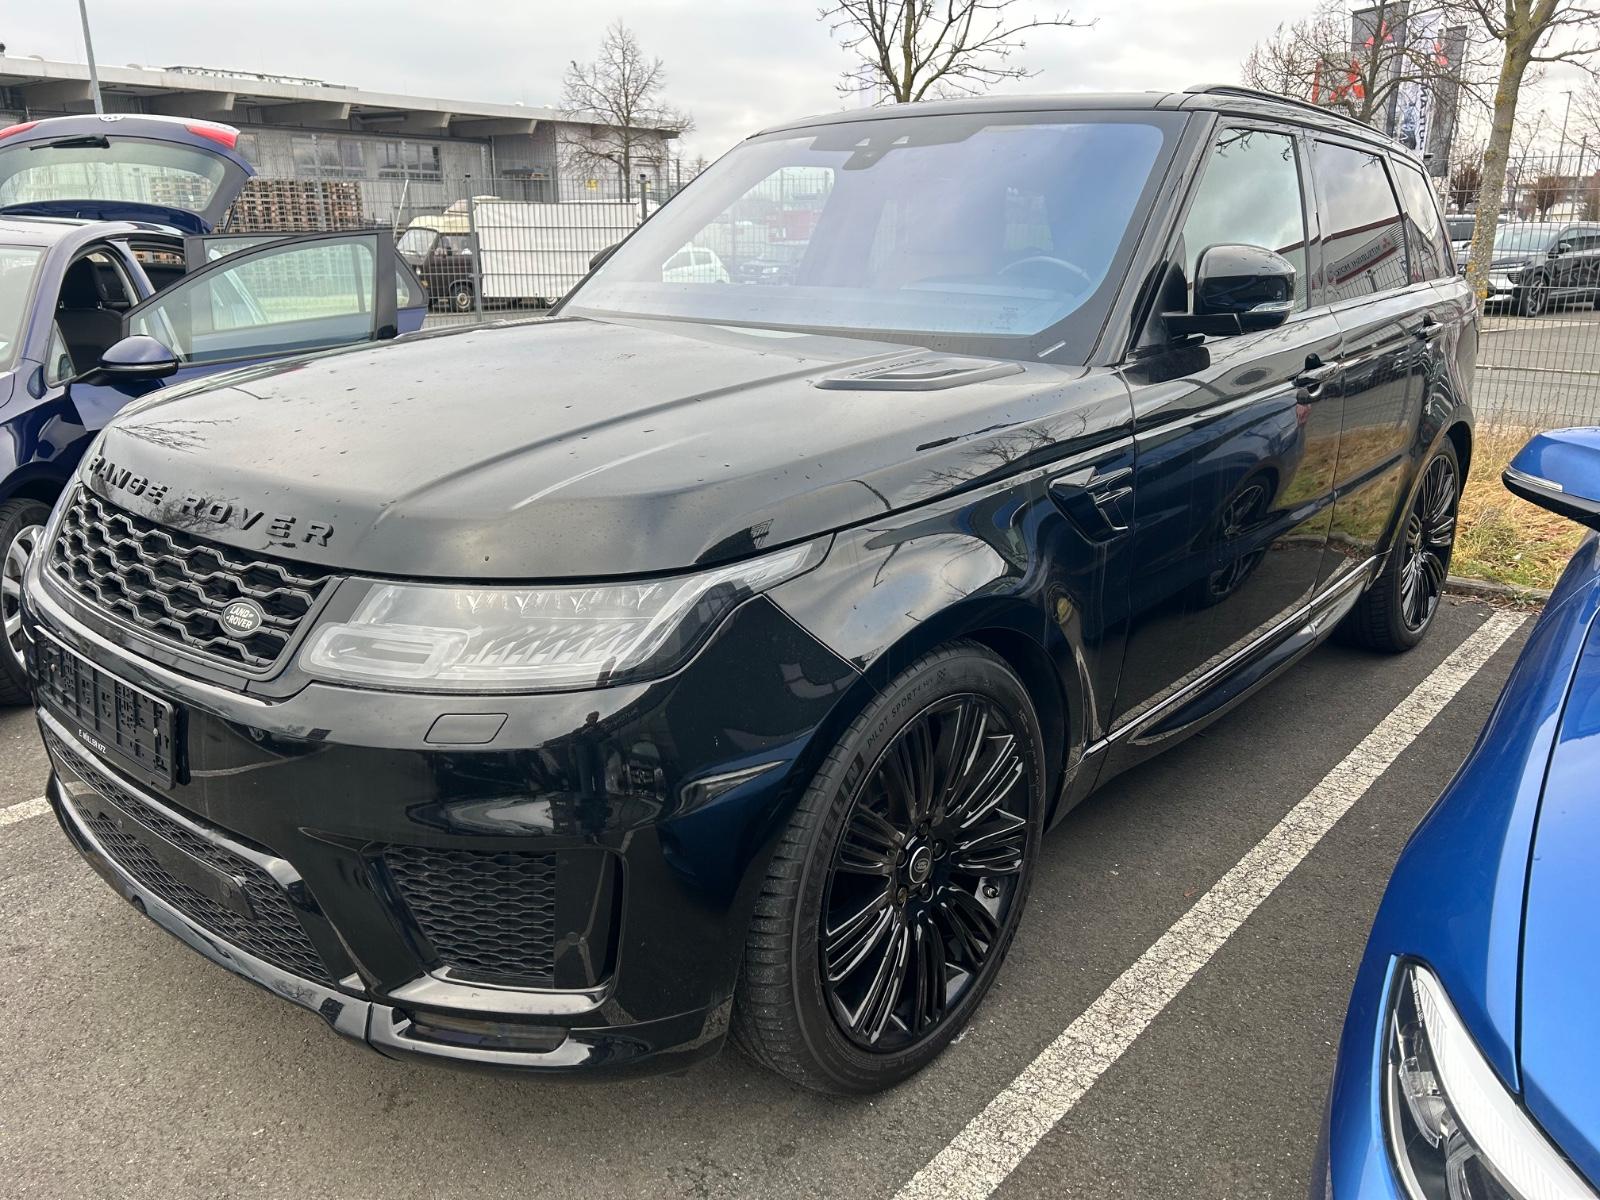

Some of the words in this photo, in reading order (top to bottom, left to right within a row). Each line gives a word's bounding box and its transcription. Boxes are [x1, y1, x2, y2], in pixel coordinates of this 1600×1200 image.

[88, 455, 168, 505] RANGE
[178, 496, 334, 547] ROVER
[228, 615, 253, 629] ROVER
[229, 605, 251, 618] LAND
[867, 718, 888, 748] PILOT
[891, 687, 918, 717] SPORT
